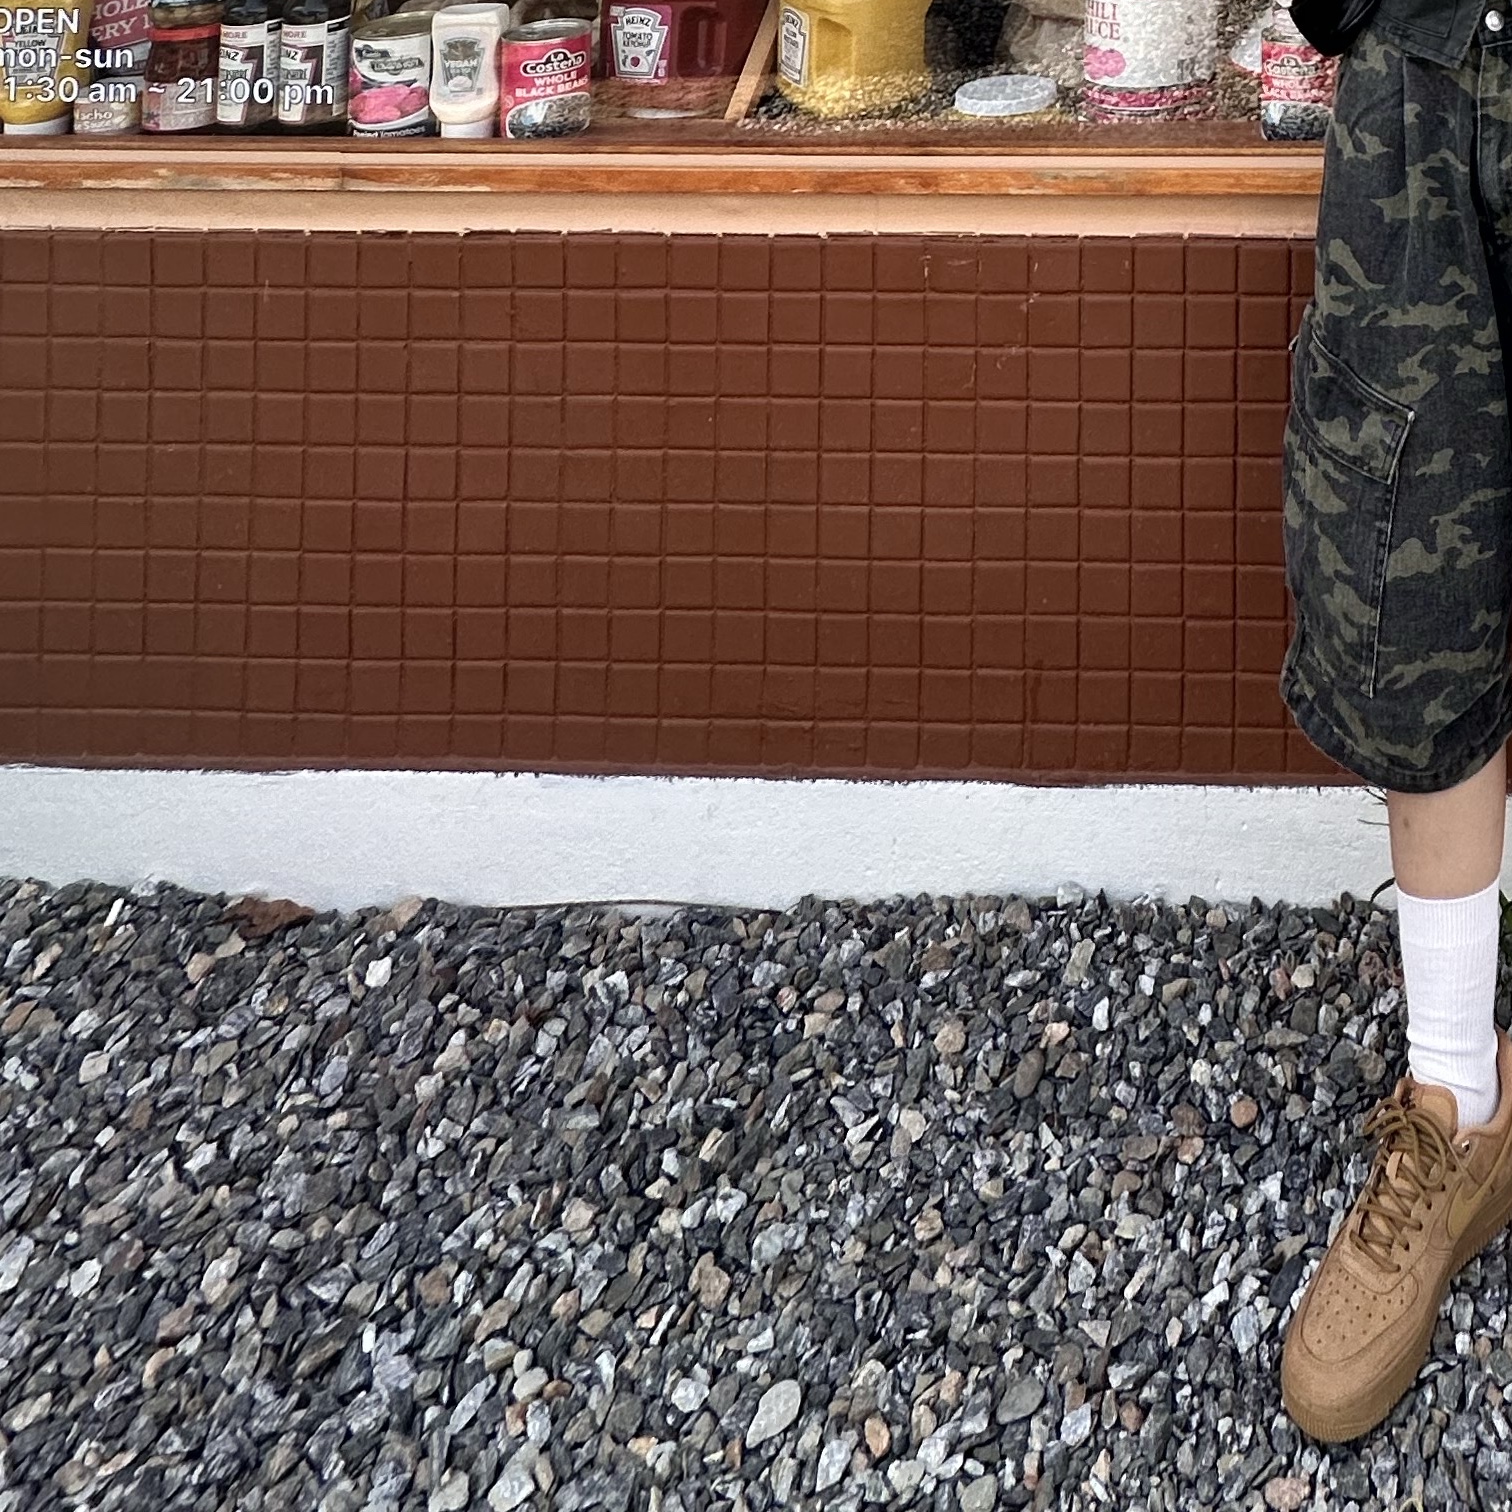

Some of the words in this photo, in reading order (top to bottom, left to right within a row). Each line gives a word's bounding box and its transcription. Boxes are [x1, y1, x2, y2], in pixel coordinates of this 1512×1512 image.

[625, 16, 652, 28] HEINZ
[550, 53, 564, 62] La
[533, 71, 578, 87] WHOLE
[88, 82, 137, 103] am
[176, 77, 274, 104] 21:00
[284, 84, 334, 111] pm
[515, 85, 557, 98] BLACK
